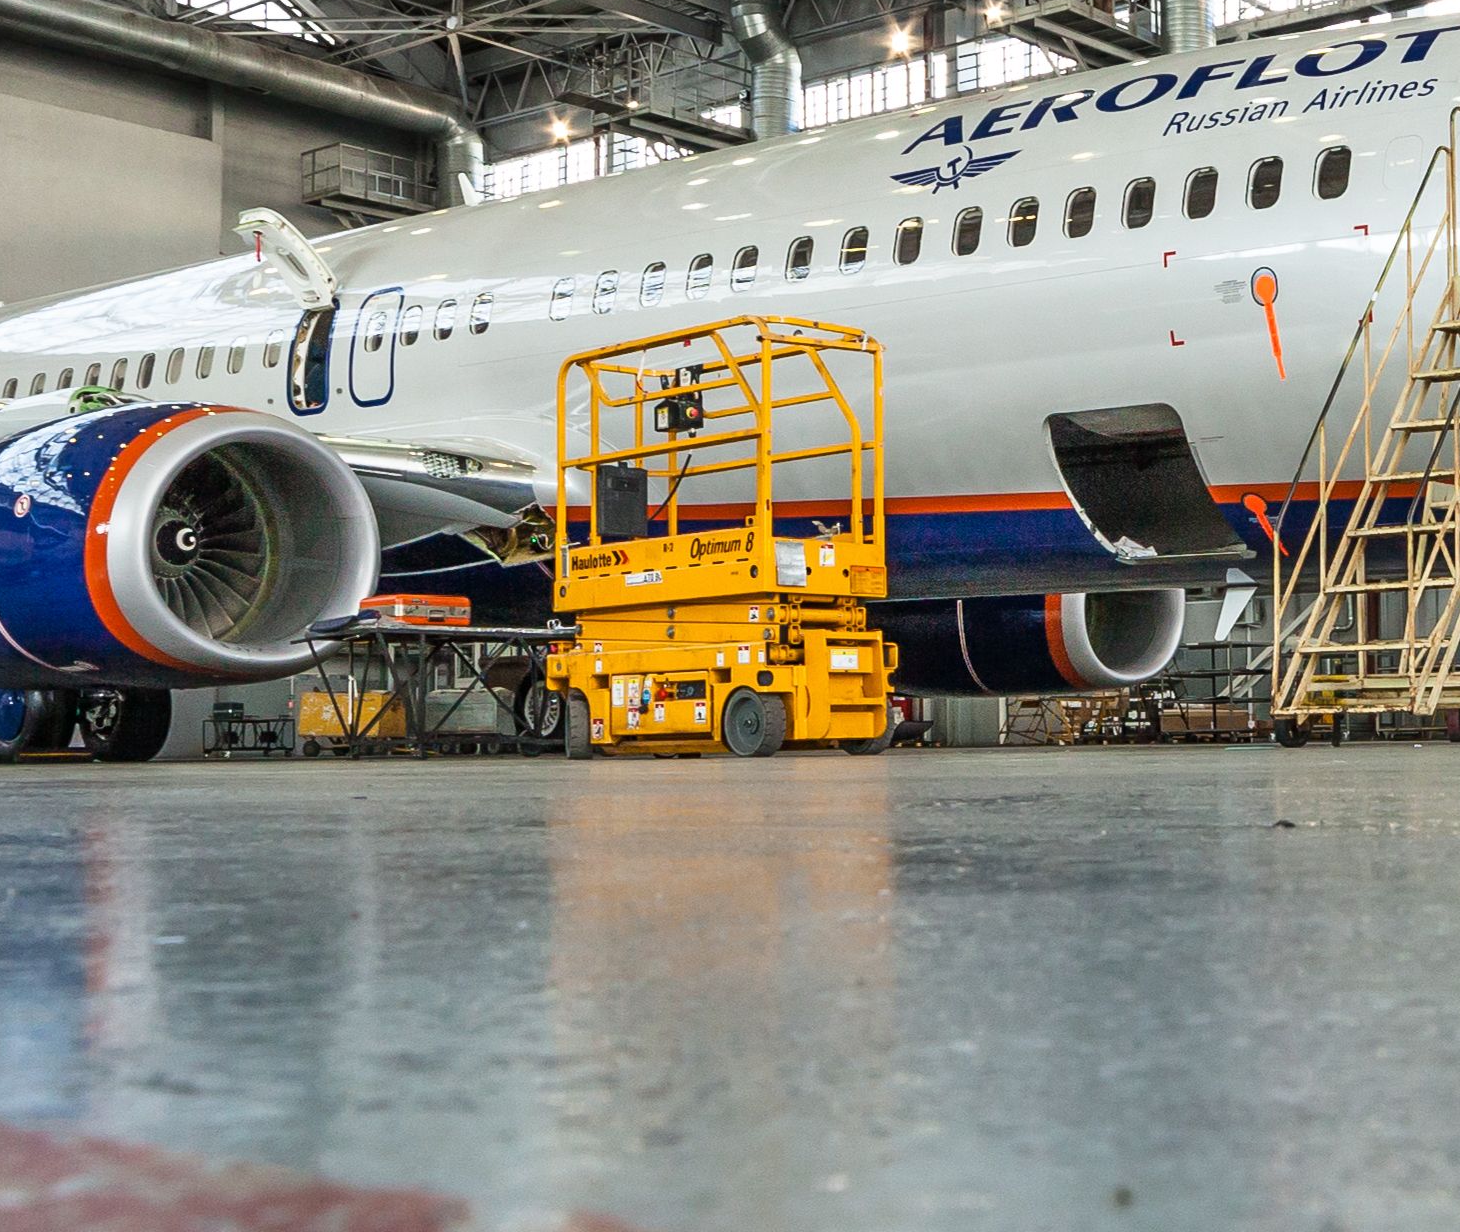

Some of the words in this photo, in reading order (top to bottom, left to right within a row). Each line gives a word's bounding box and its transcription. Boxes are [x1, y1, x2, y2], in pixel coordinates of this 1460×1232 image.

[1163, 96, 1289, 137] Russian
[1303, 77, 1439, 114] Airlines
[690, 537, 741, 560] Optimum
[745, 531, 755, 552] 8
[571, 553, 612, 571] Haulotte
